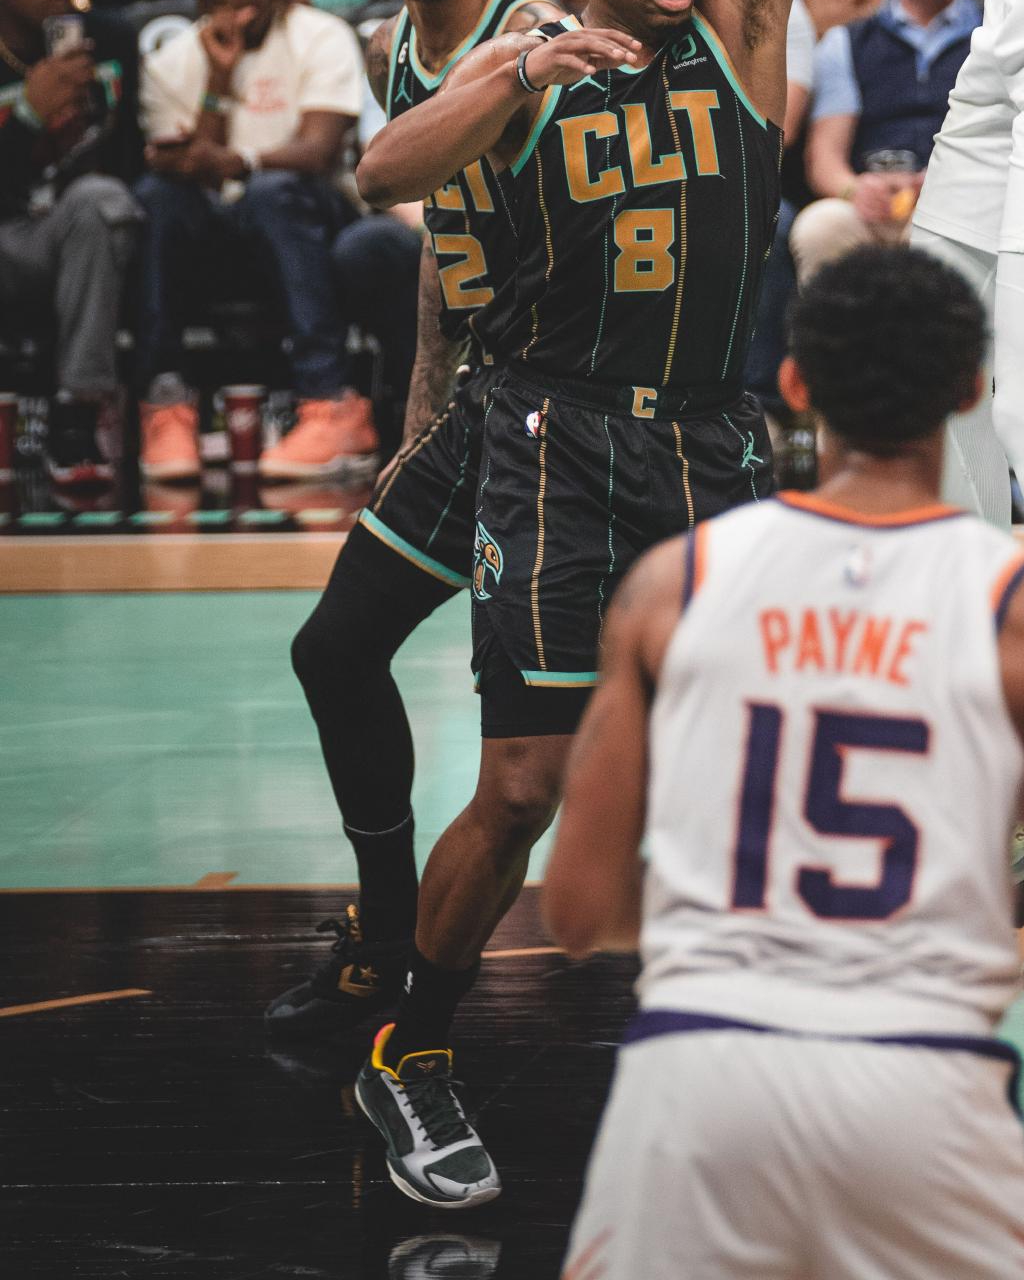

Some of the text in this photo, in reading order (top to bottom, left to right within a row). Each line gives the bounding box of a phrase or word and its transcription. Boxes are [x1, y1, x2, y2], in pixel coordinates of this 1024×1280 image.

[556, 89, 720, 204] CLT
[431, 233, 495, 310] 2
[614, 208, 675, 293] 8
[758, 605, 931, 687] PAYNE
[730, 697, 931, 922] 15
